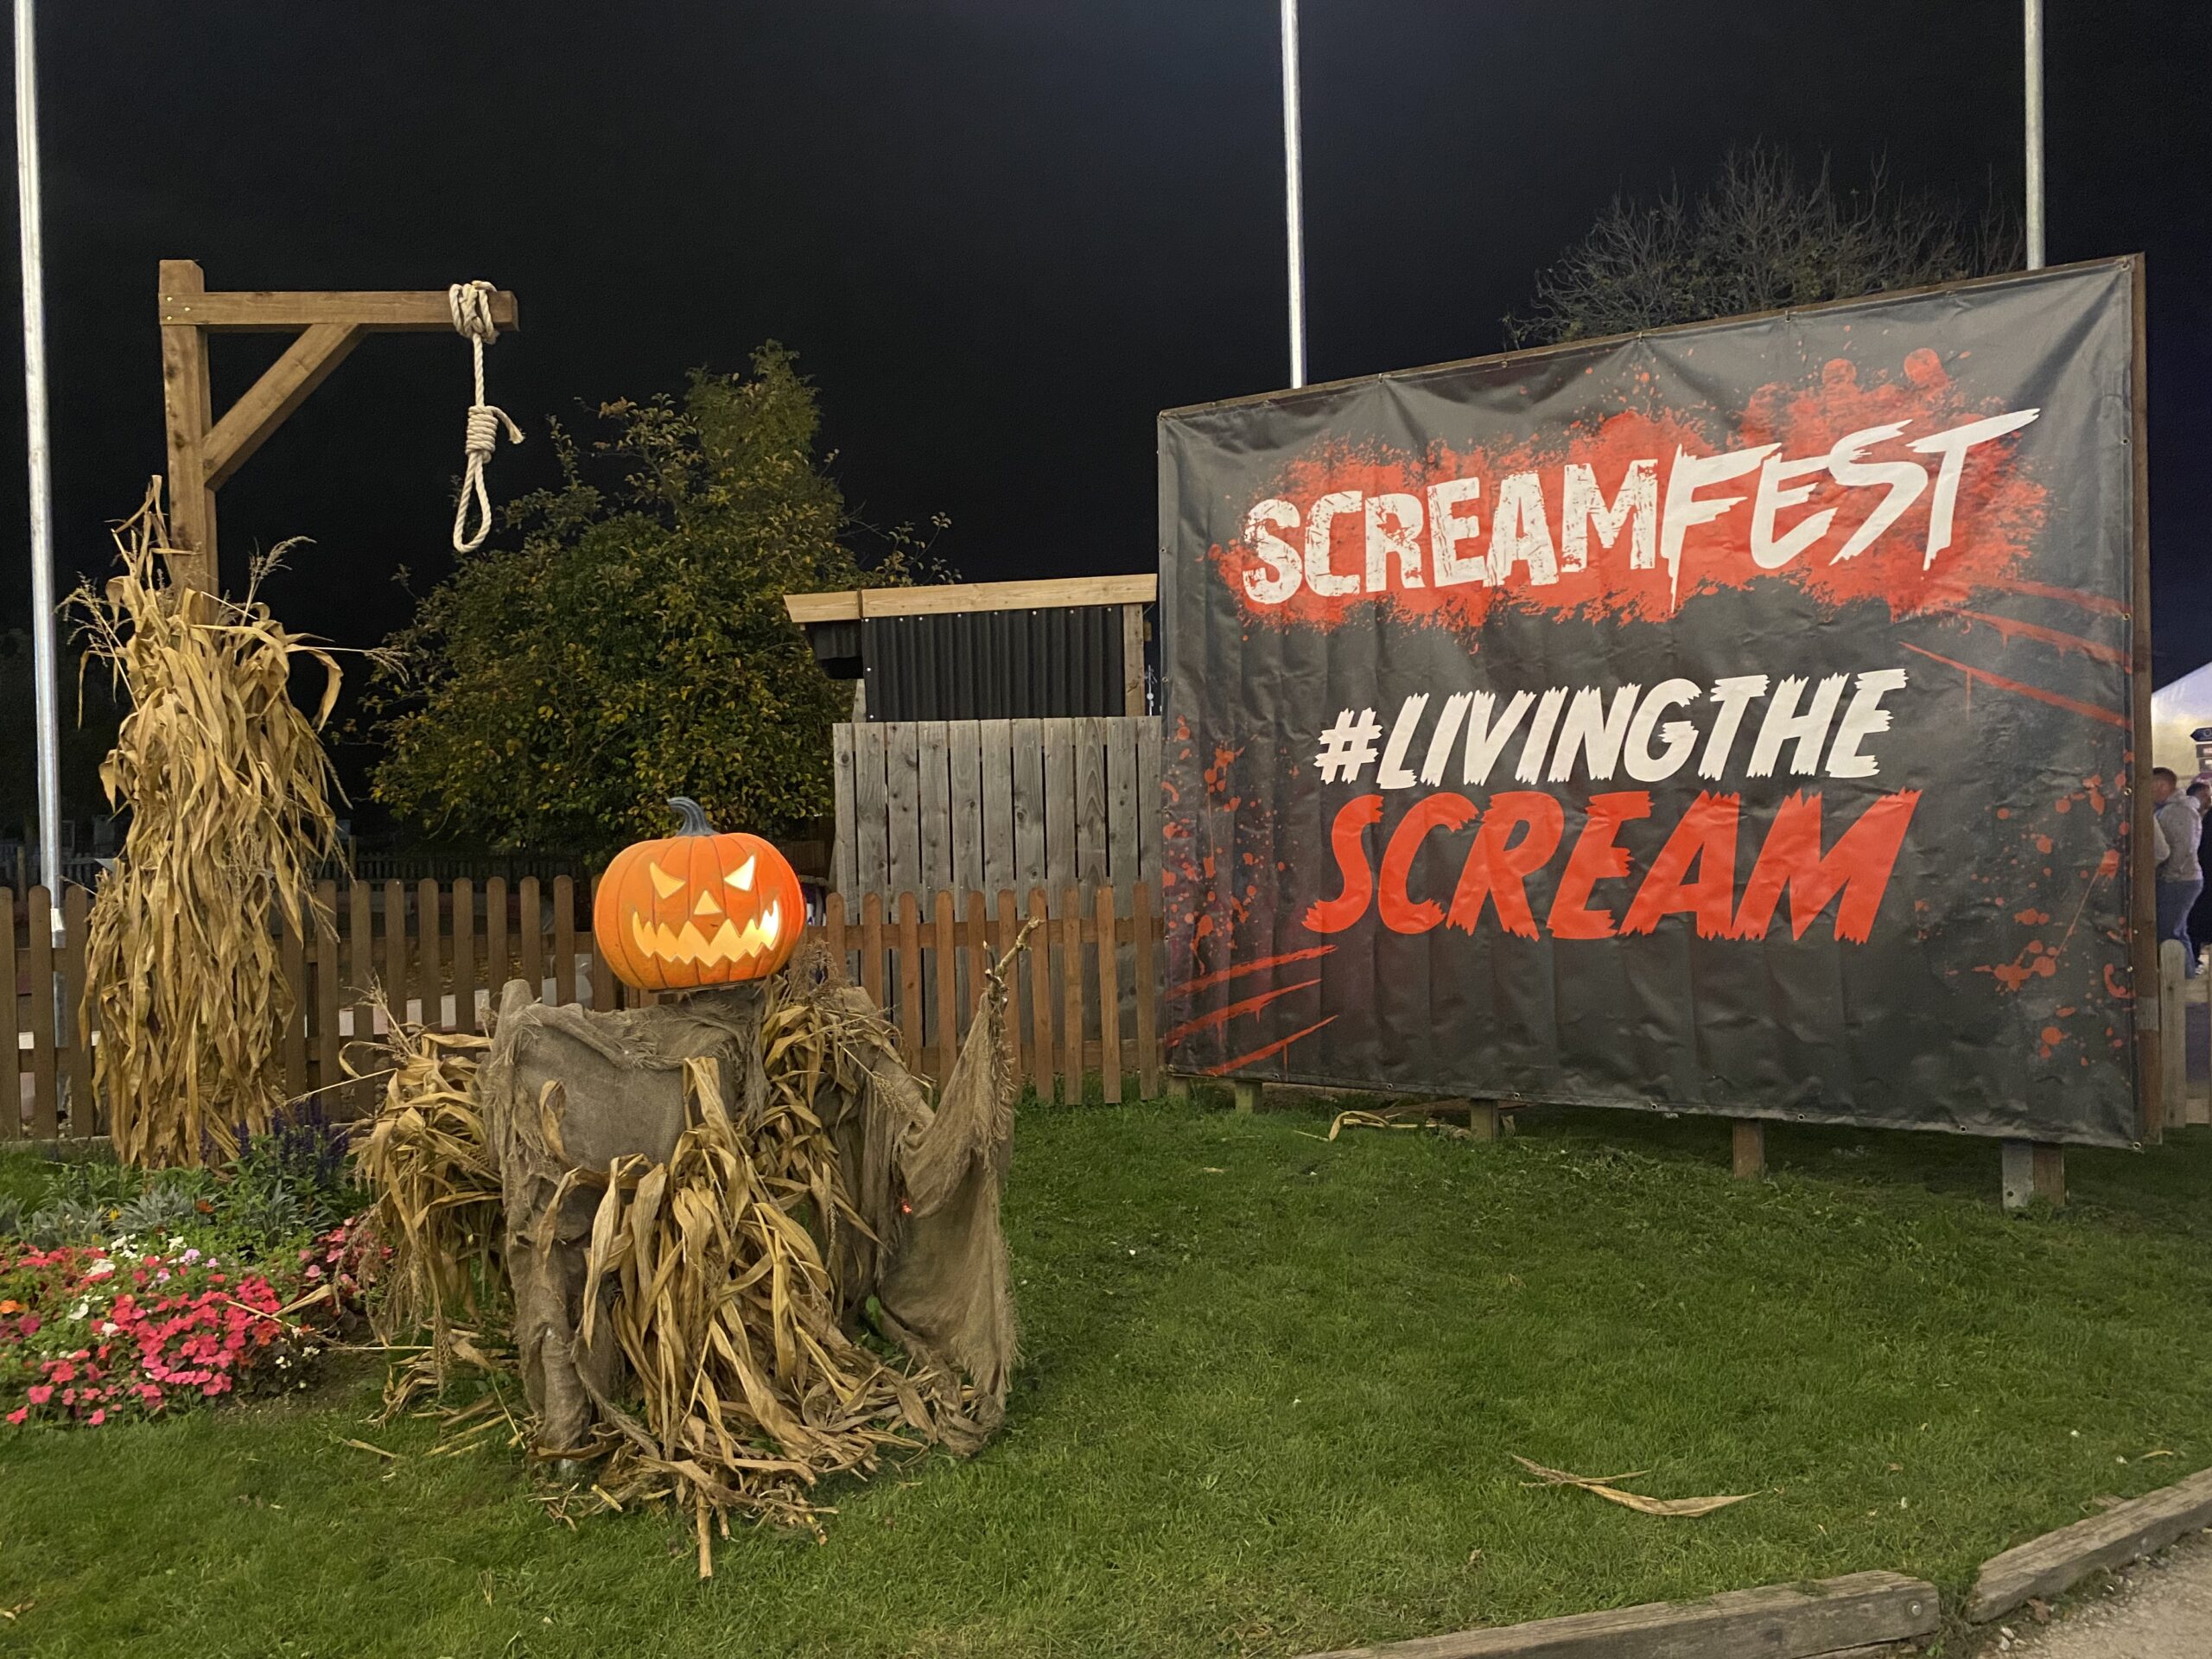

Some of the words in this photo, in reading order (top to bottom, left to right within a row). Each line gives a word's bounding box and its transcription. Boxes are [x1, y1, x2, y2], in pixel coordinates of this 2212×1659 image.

[1243, 409, 2040, 613] SCREAMFEST
[1313, 669, 1908, 789] #LIVINGTHE
[1302, 789, 1921, 944] SCREAM
